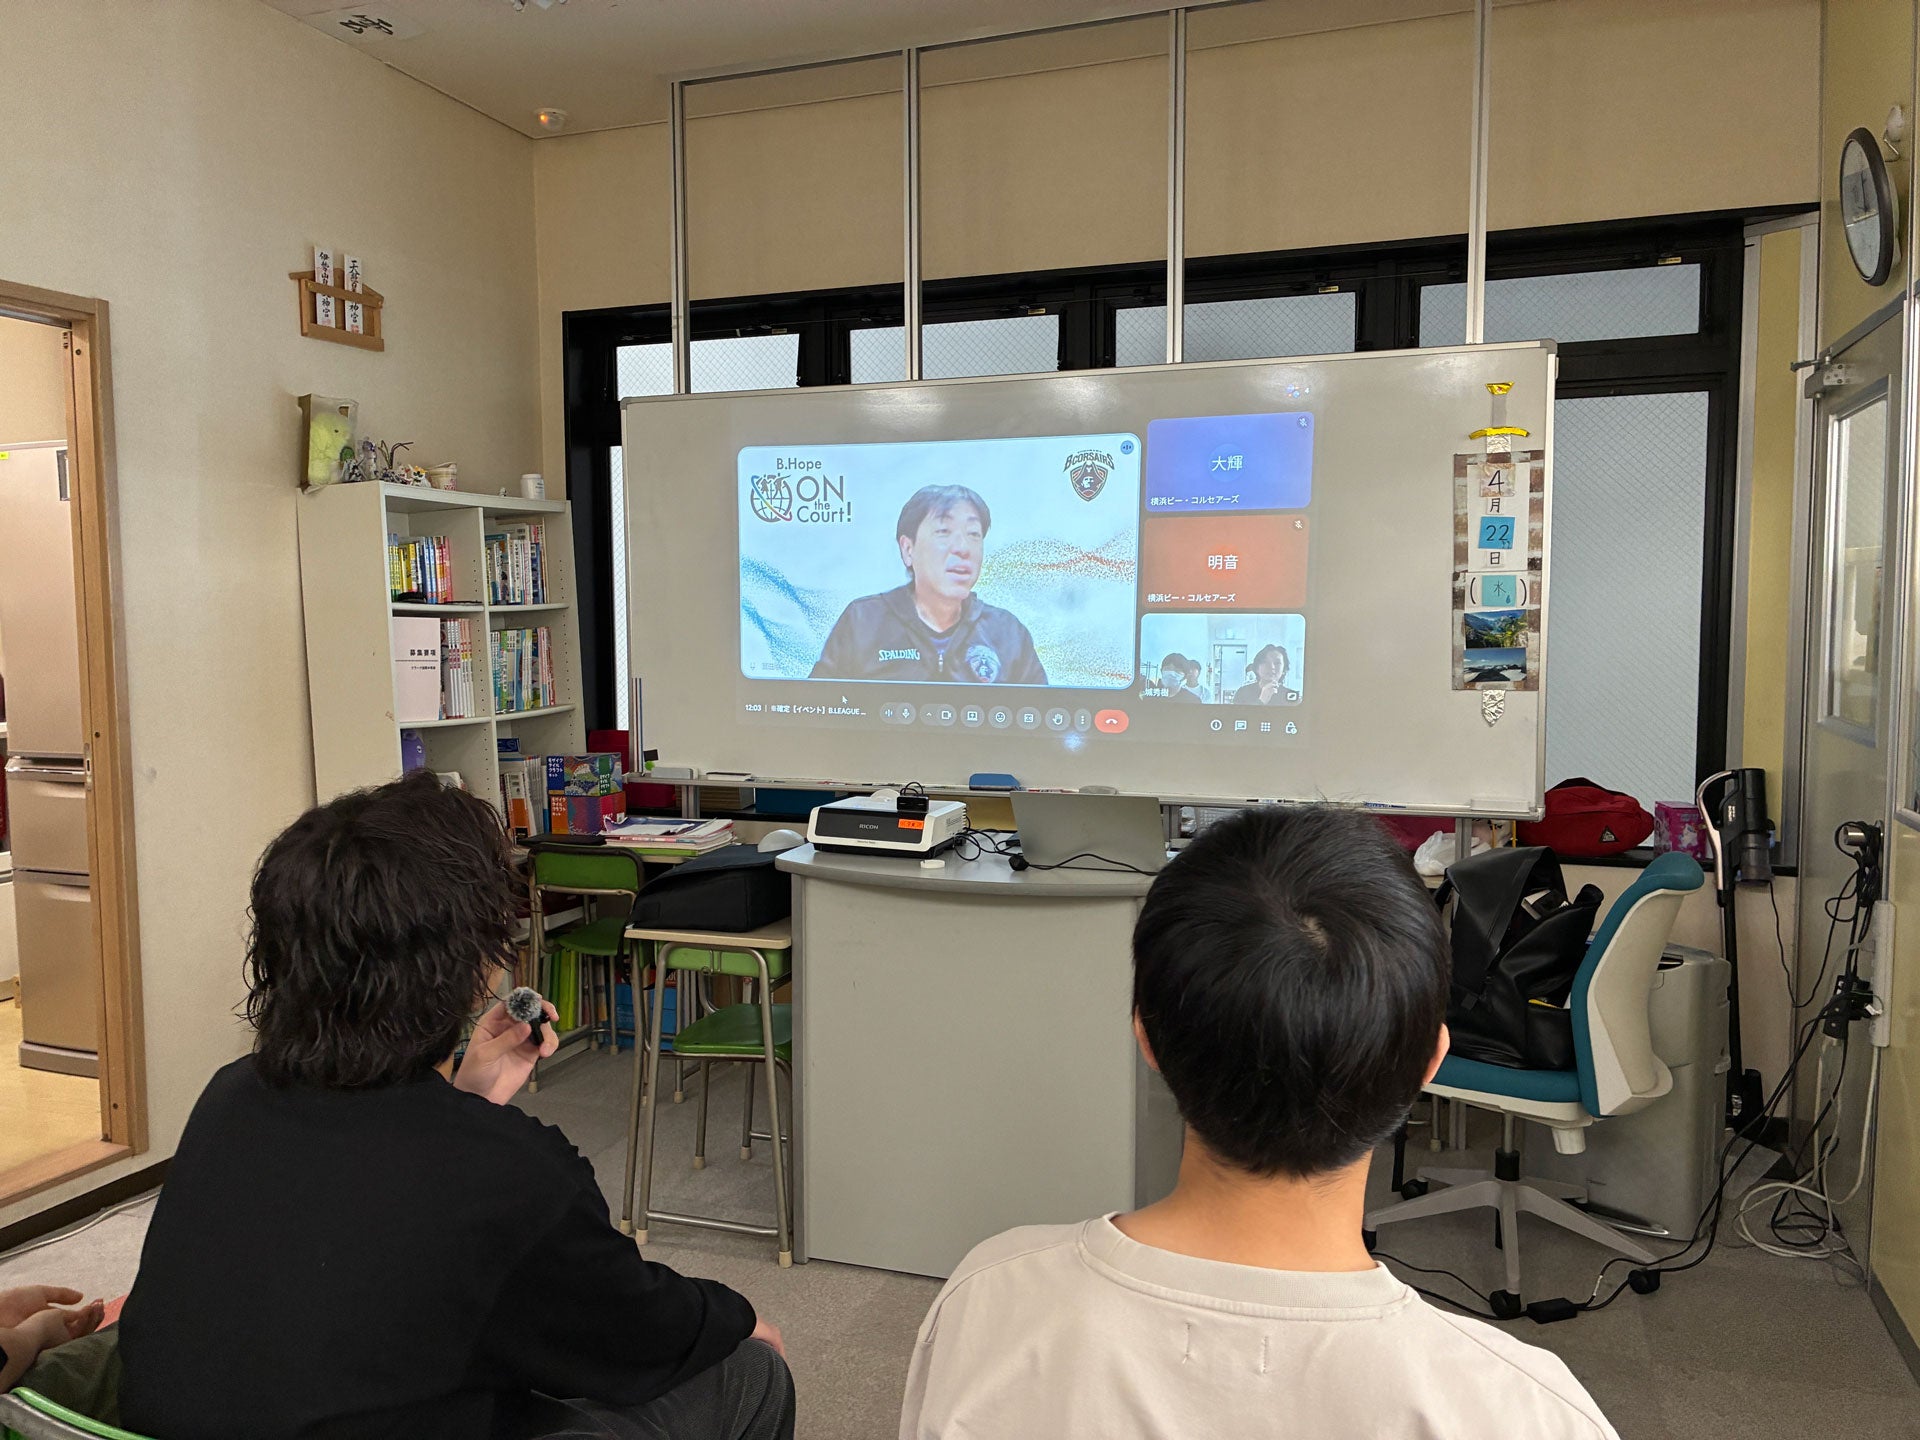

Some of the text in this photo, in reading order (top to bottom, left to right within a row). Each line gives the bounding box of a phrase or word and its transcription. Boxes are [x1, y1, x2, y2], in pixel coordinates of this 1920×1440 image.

[776, 457, 822, 472] B.Hope
[1211, 454, 1244, 472] 大輝
[796, 474, 845, 503] ON
[796, 501, 852, 523] Court!
[814, 498, 831, 511] the
[1207, 554, 1239, 571] 明音
[878, 648, 921, 661] SPALDING
[744, 704, 762, 712] 12:03
